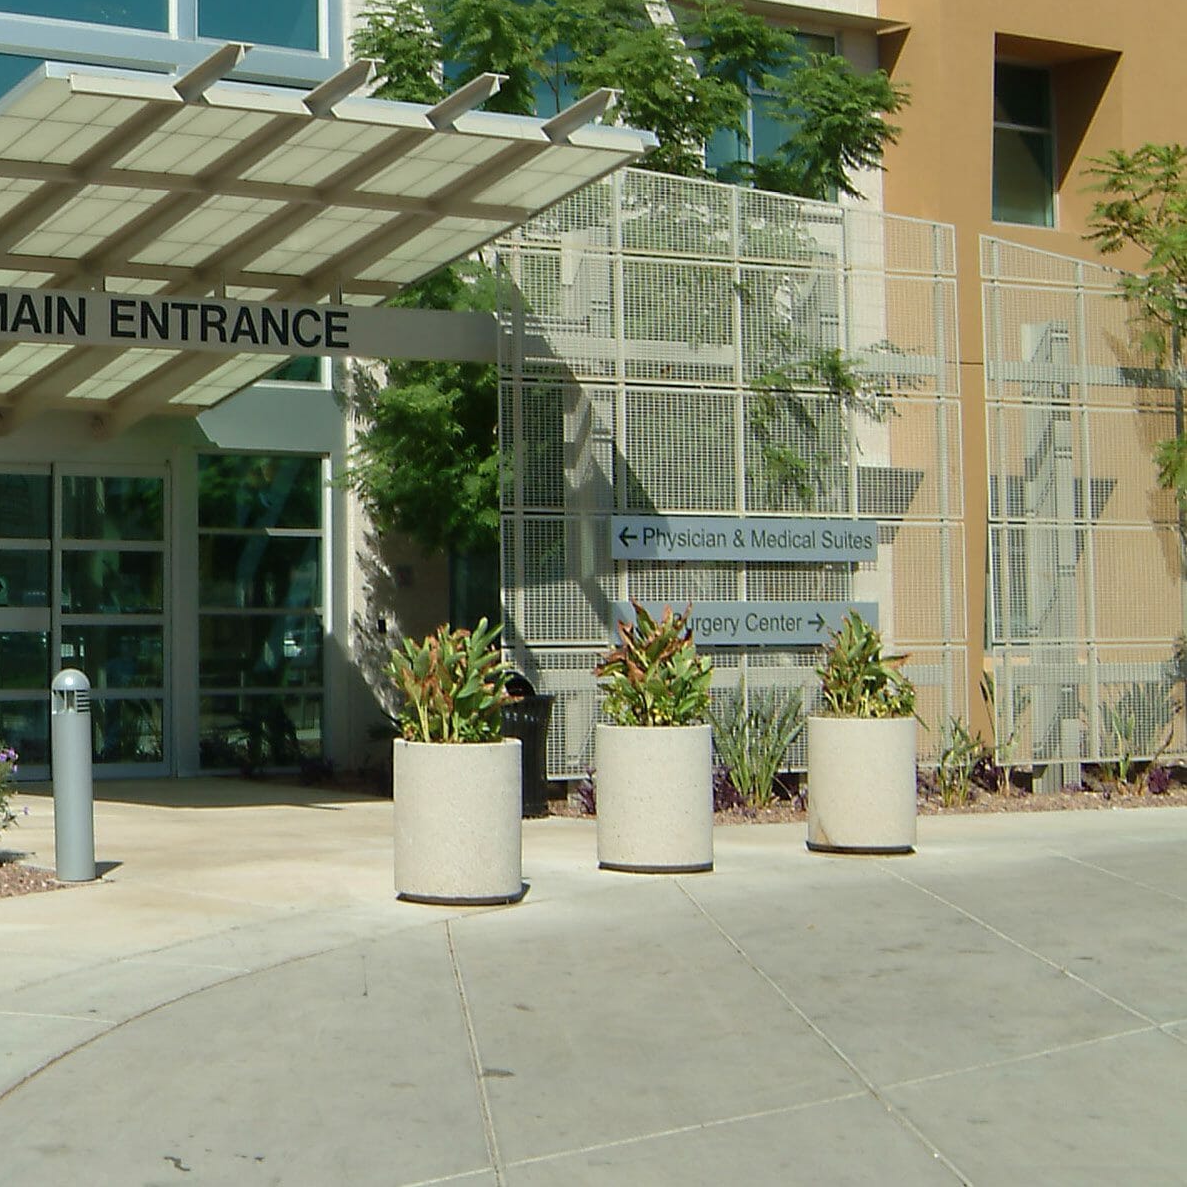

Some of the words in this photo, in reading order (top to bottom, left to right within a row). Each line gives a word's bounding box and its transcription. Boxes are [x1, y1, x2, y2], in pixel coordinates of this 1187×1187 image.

[109, 299, 350, 349] ENTRANCE
[643, 527, 727, 552] Physician
[732, 528, 746, 548] &
[751, 529, 816, 549] Medical
[821, 530, 873, 550] Suites
[744, 612, 803, 632] Center
